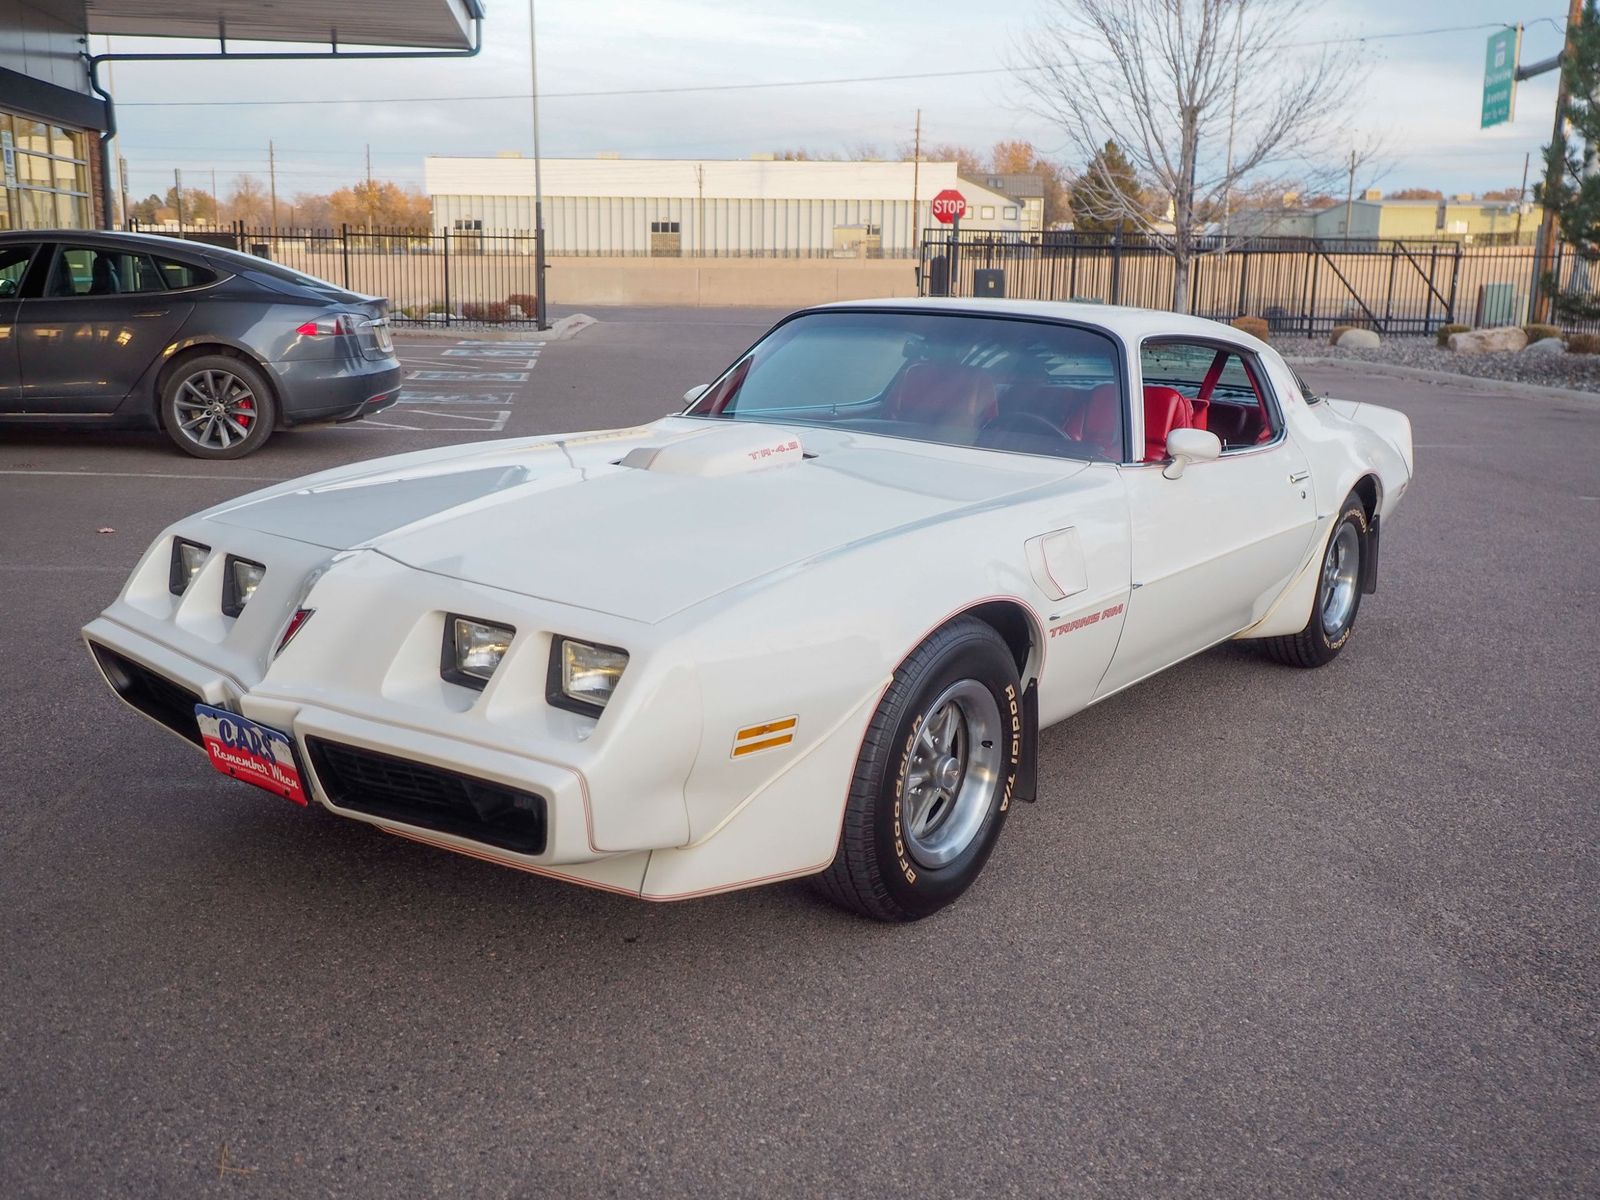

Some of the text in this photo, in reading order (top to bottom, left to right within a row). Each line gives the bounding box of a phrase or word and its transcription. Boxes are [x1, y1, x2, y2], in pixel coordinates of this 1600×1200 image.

[934, 199, 965, 213] STOP
[1049, 603, 1124, 638] TRANS AM
[219, 719, 276, 764] CARS
[1000, 684, 1021, 812] Radial T/A
[210, 742, 268, 775] Remember
[269, 762, 299, 789] When
[895, 714, 923, 884] BFGoodrich
